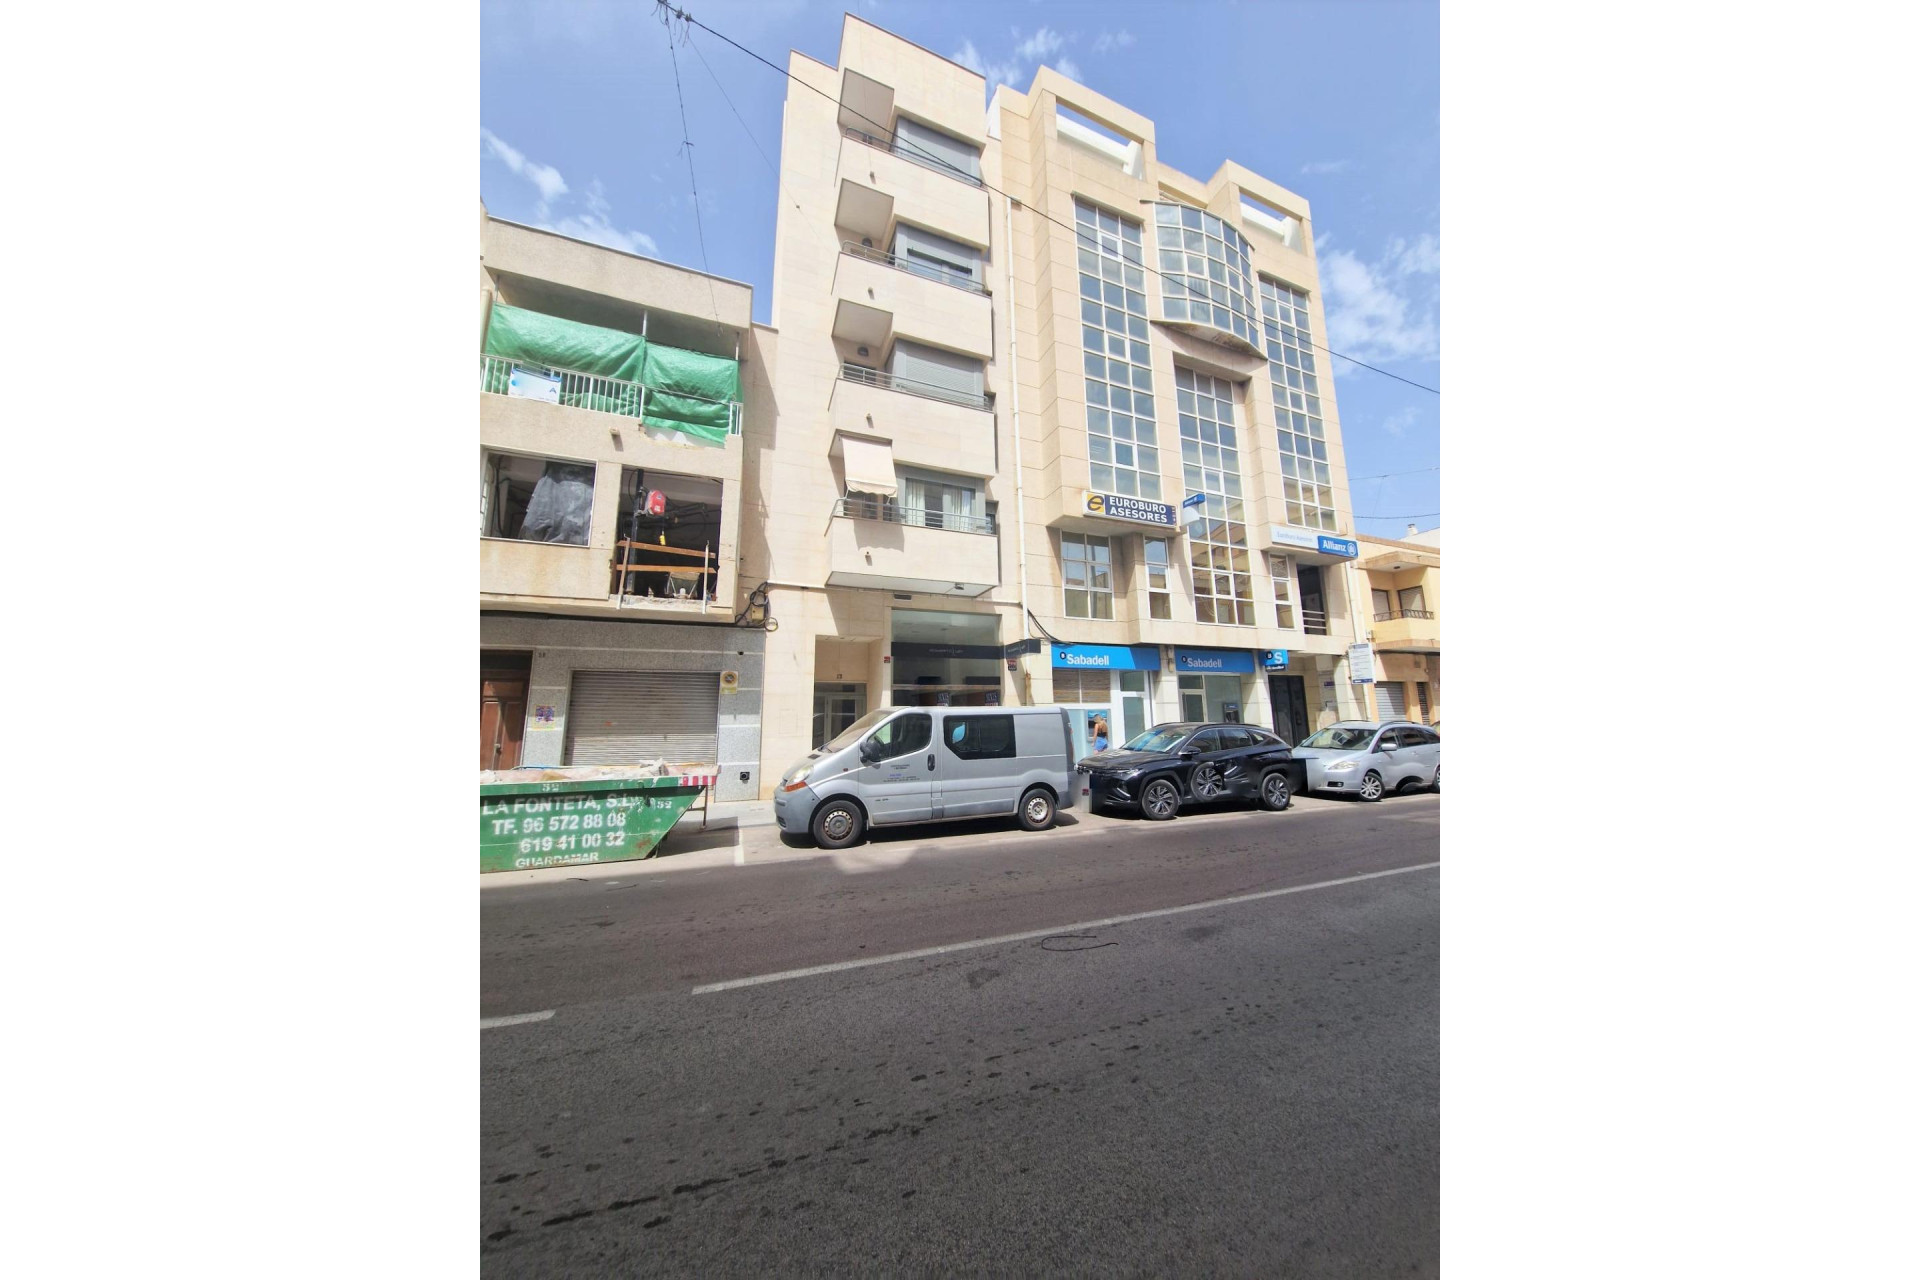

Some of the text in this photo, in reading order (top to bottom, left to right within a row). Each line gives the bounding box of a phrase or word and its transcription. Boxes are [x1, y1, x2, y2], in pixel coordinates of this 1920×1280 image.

[1109, 496, 1167, 514] EUROBURO
[1110, 506, 1168, 523] ASESORES
[1322, 539, 1347, 552] Allianz
[1067, 654, 1109, 665] Sabadell
[1187, 657, 1222, 668] Sabadell
[1274, 652, 1283, 664] S
[483, 799, 509, 815] LA
[514, 795, 601, 814] FONTETA,
[492, 818, 518, 835] TF.
[523, 817, 544, 833] 96
[549, 814, 579, 831] 572
[583, 813, 603, 829] 88
[520, 831, 625, 853] 619 41 00 32
[515, 852, 599, 868] GUARDAMAR
